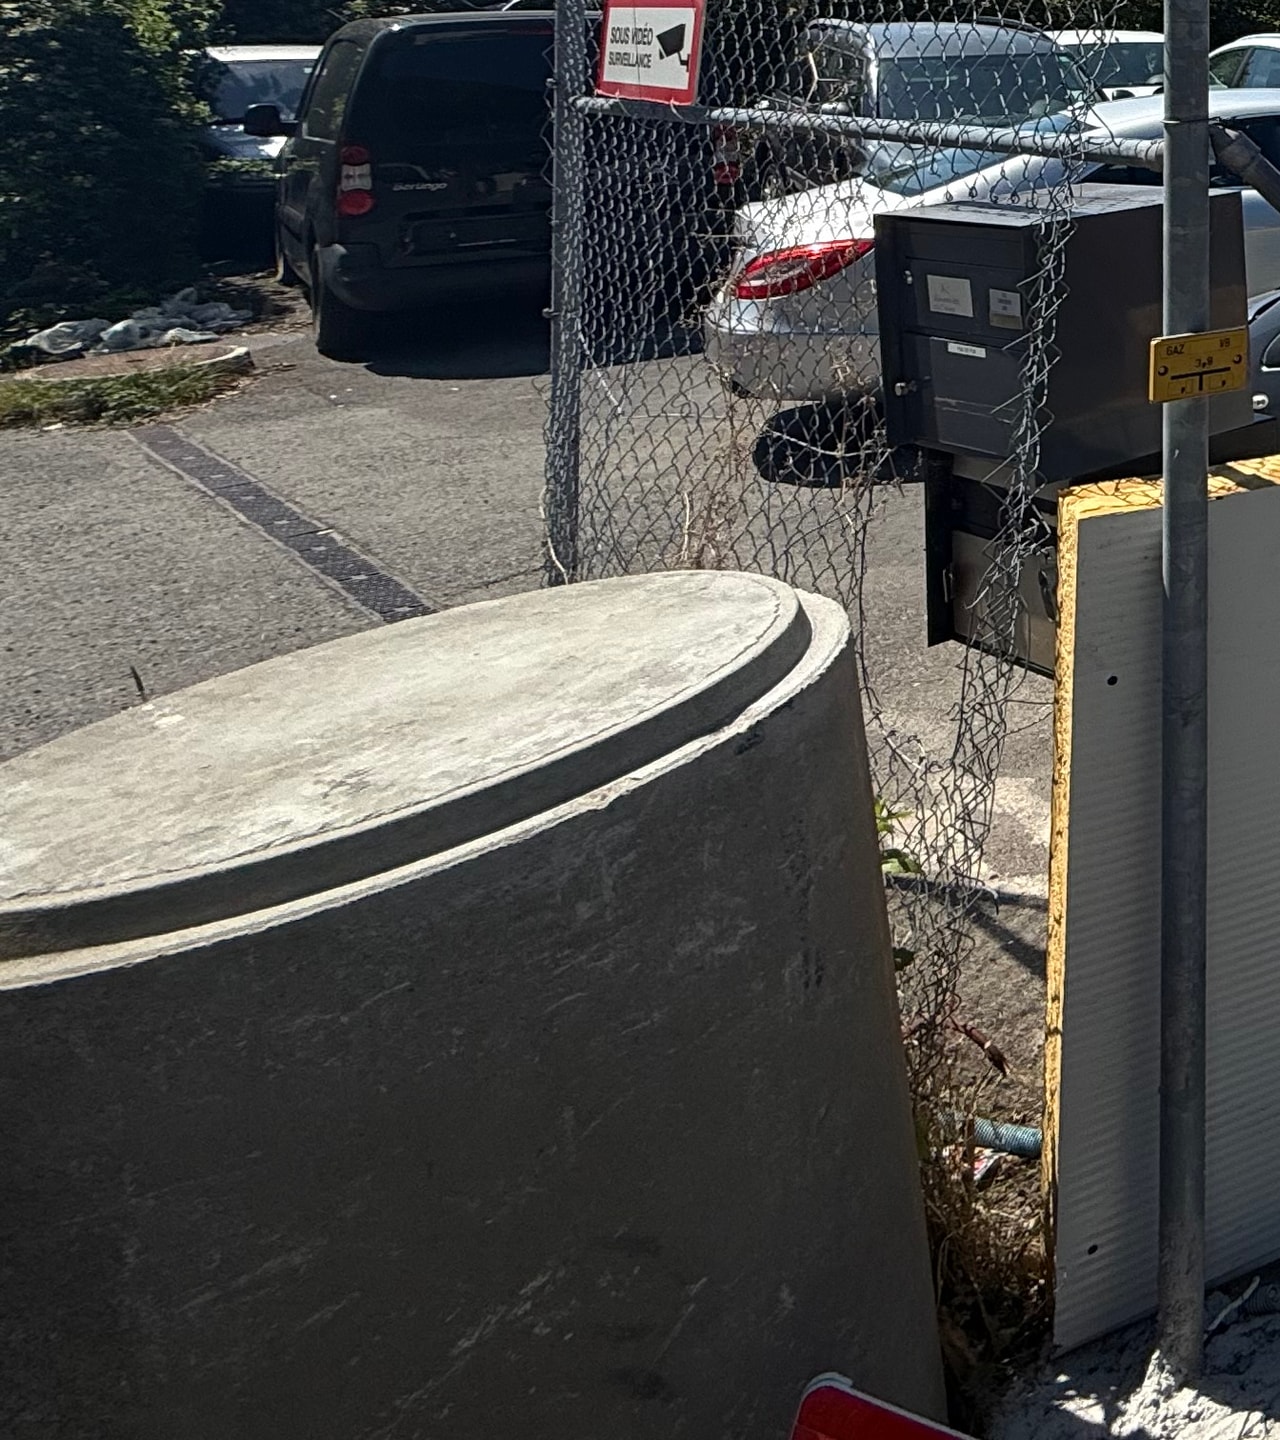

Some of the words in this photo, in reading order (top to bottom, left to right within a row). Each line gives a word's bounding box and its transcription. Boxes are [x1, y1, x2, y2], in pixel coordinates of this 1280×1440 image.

[610, 26, 630, 44] SOUS
[631, 22, 654, 45] VIDÉO
[608, 51, 652, 68] SURVEILLANCE
[1166, 343, 1185, 356] GAZ
